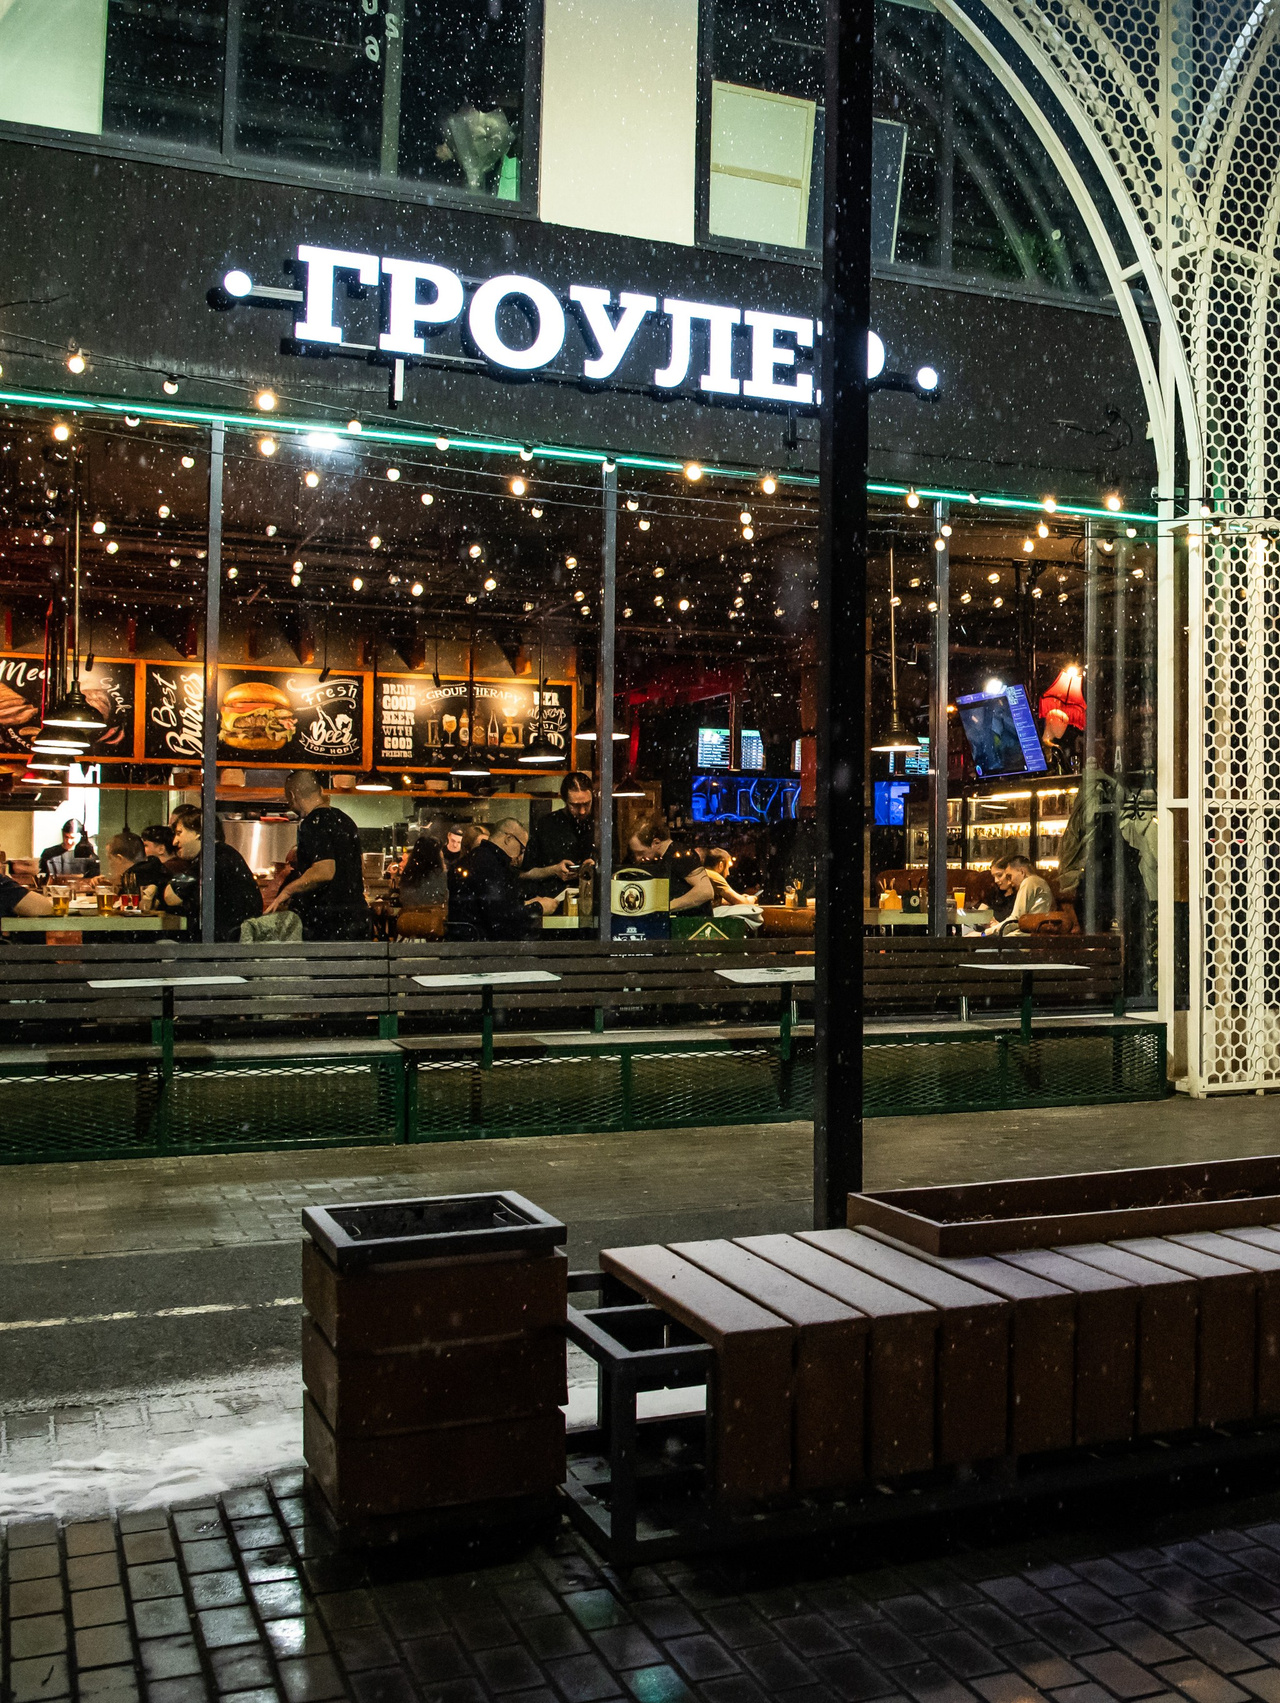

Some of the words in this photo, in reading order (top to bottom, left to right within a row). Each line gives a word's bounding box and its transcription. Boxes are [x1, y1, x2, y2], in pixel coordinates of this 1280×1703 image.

[0, 659, 52, 687] Mea
[151, 672, 178, 728] Best
[301, 684, 358, 705] Fresh
[426, 686, 467, 699] GROUP
[382, 695, 416, 711] GOOD
[382, 711, 415, 725] BEER
[310, 720, 352, 745] Beer
[382, 725, 413, 736] WITH
[310, 744, 325, 752] TOP
[384, 736, 413, 749] GOOD
